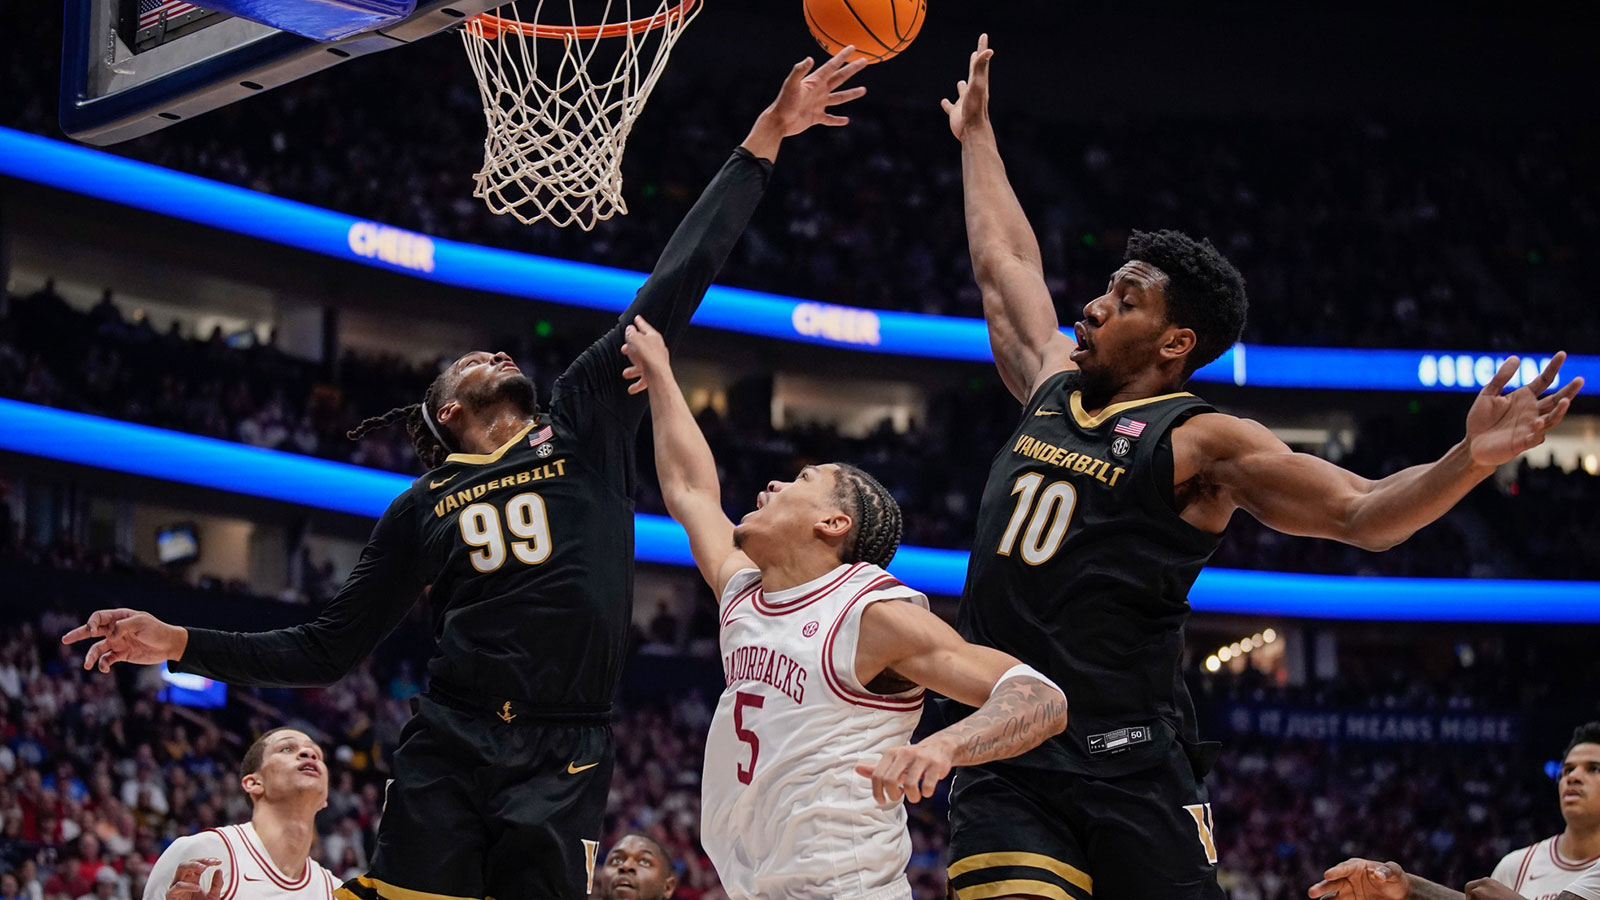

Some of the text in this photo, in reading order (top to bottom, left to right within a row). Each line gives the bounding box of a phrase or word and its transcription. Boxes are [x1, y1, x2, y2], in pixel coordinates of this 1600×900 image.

[348, 222, 435, 273] CHEER
[792, 303, 881, 346] CHEER
[1012, 434, 1126, 487] VANDERBILT
[434, 459, 566, 518] VANDERBILT
[459, 492, 553, 573] 99
[997, 471, 1077, 566] 10
[734, 691, 765, 786] 5
[966, 733, 1001, 762] Fear
[1003, 715, 1031, 743] No
[1130, 730, 1142, 739] 50
[1346, 716, 1434, 740] MEANS
[1440, 718, 1510, 741] MORE
